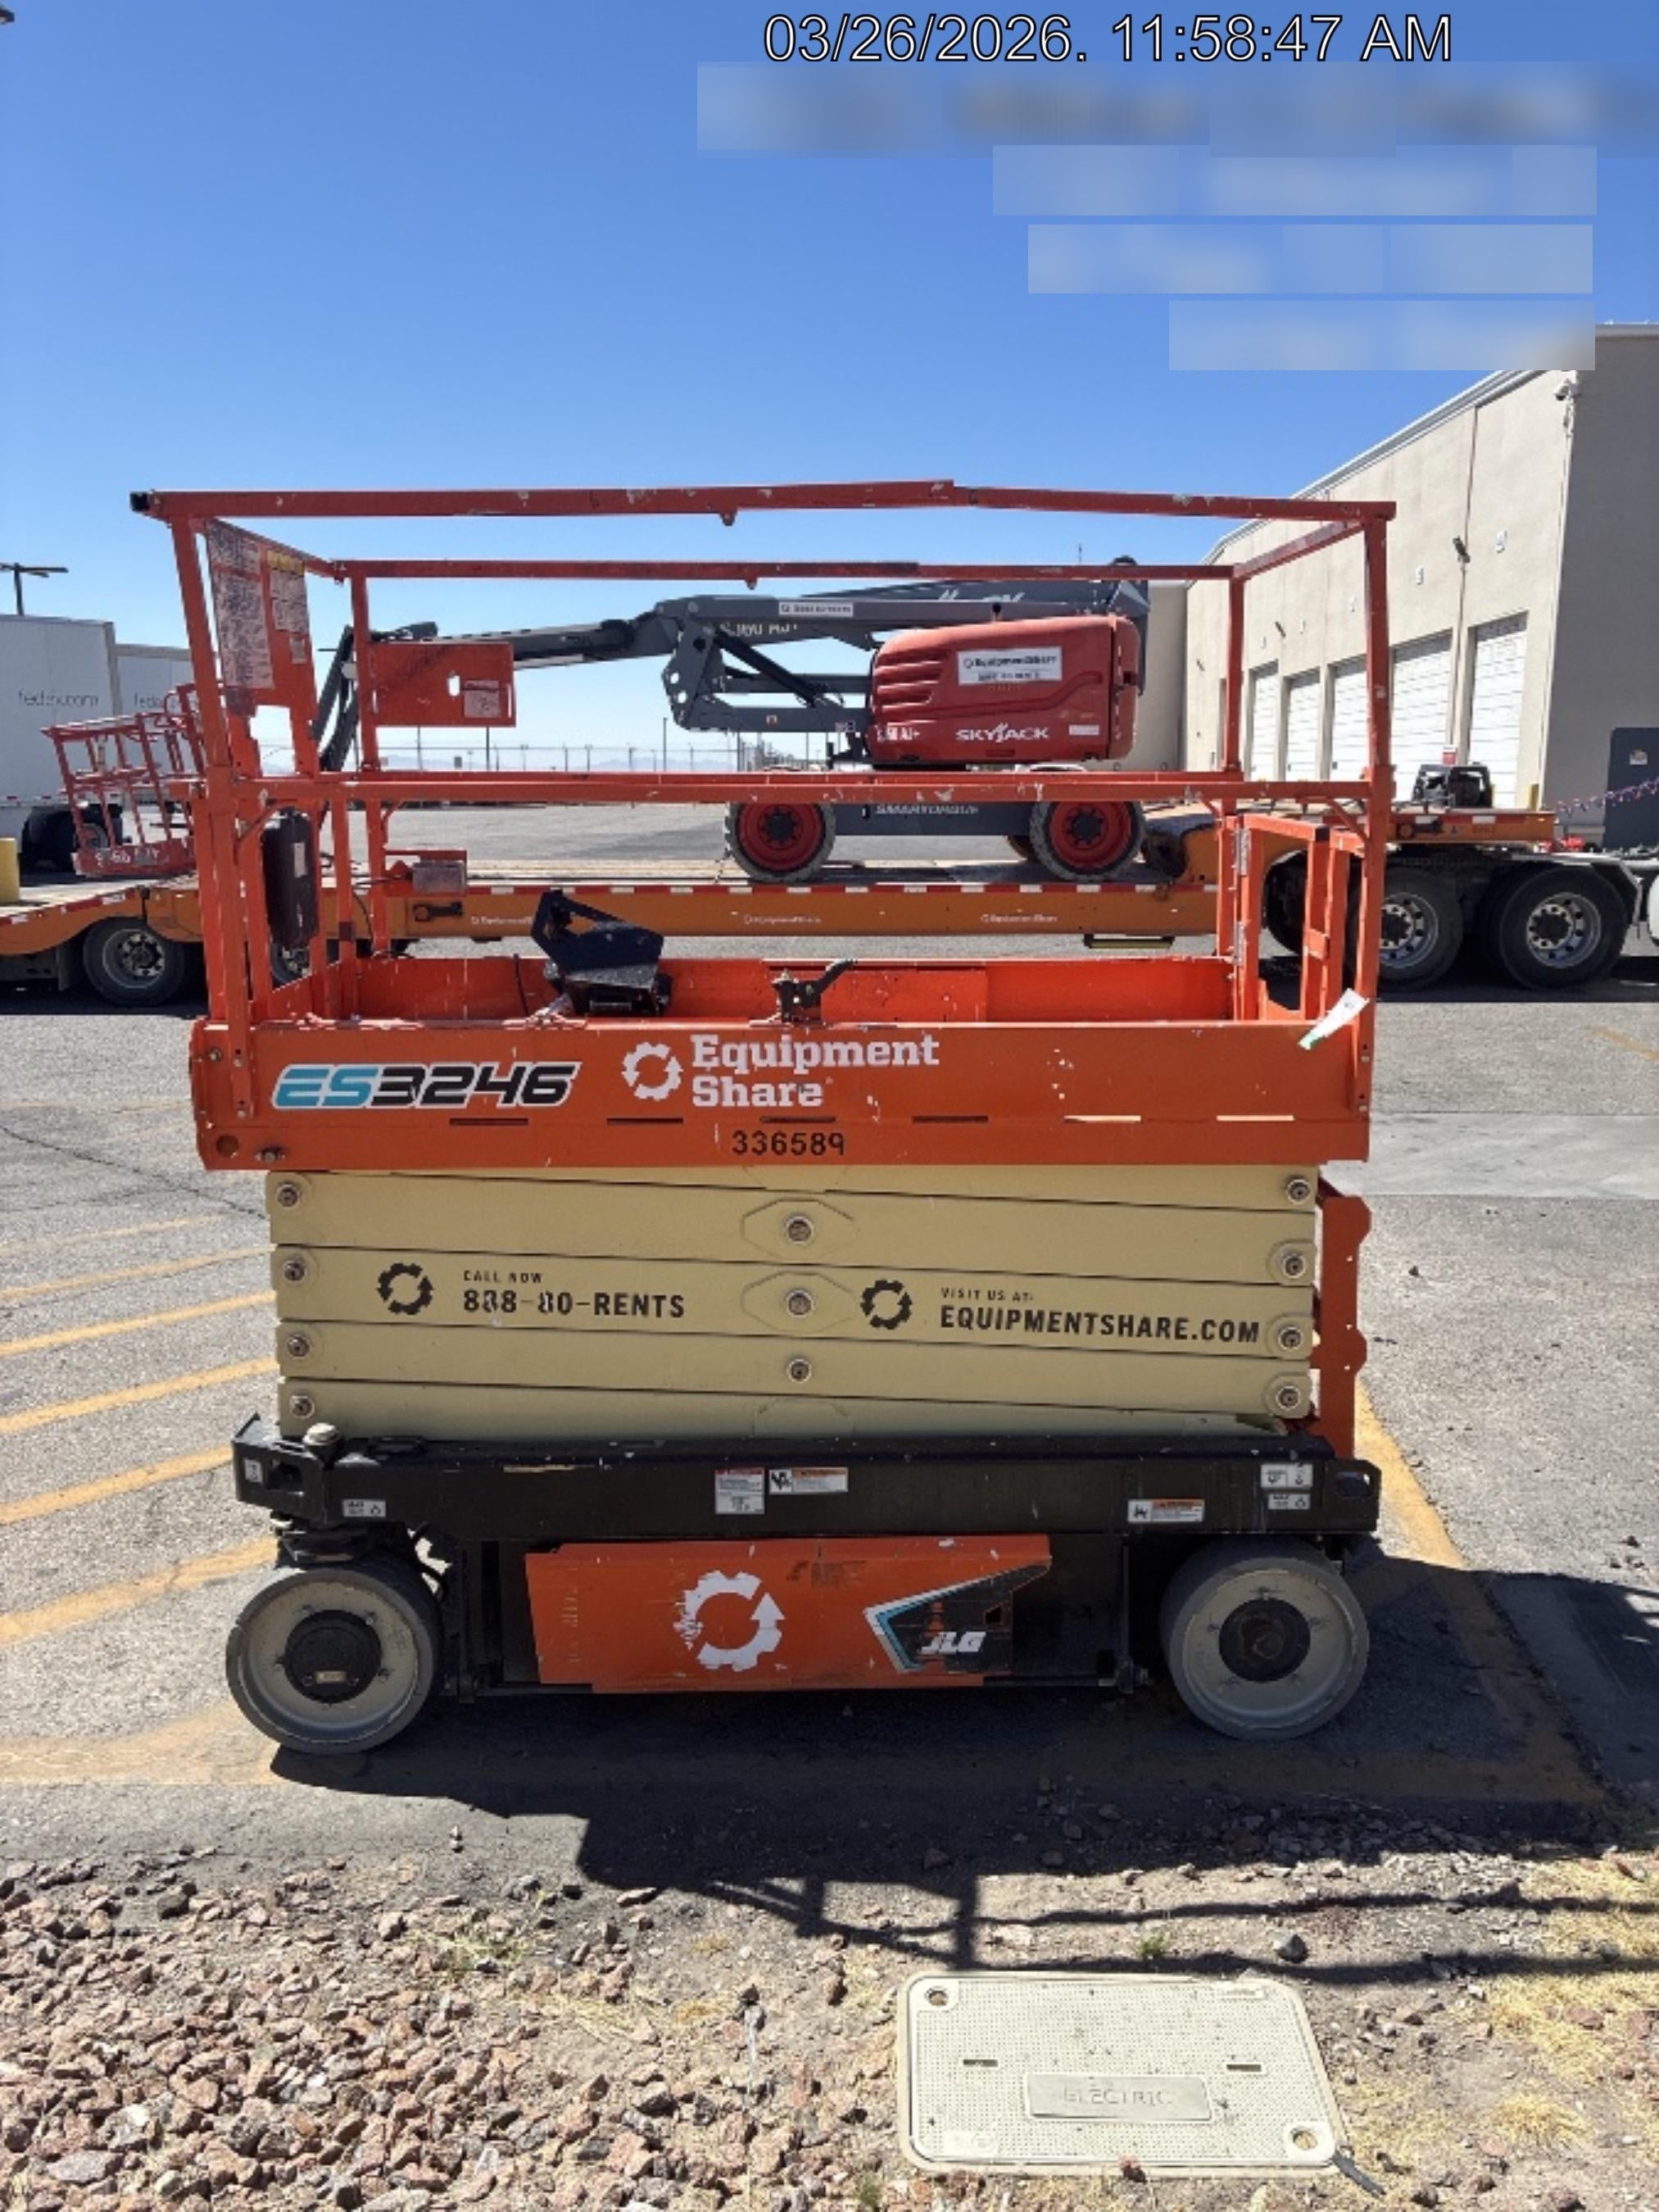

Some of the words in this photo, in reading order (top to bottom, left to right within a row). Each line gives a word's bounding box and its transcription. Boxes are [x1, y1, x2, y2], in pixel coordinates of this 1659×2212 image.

[955, 722, 1049, 743] SKYJACK
[691, 1034, 941, 1075] Equipment
[271, 1062, 582, 1109] ES3246
[691, 1075, 824, 1108] Share
[732, 1131, 845, 1156] 336589
[463, 1270, 501, 1283] CALL
[508, 1271, 543, 1284] NOW
[941, 1287, 981, 1301] VISIT
[987, 1290, 1005, 1301] US
[941, 1304, 1260, 1344] EQUIPMENTSHARE.COM
[919, 1631, 987, 1656] JLG
[1063, 2087, 1173, 2108] ELECTRIC
